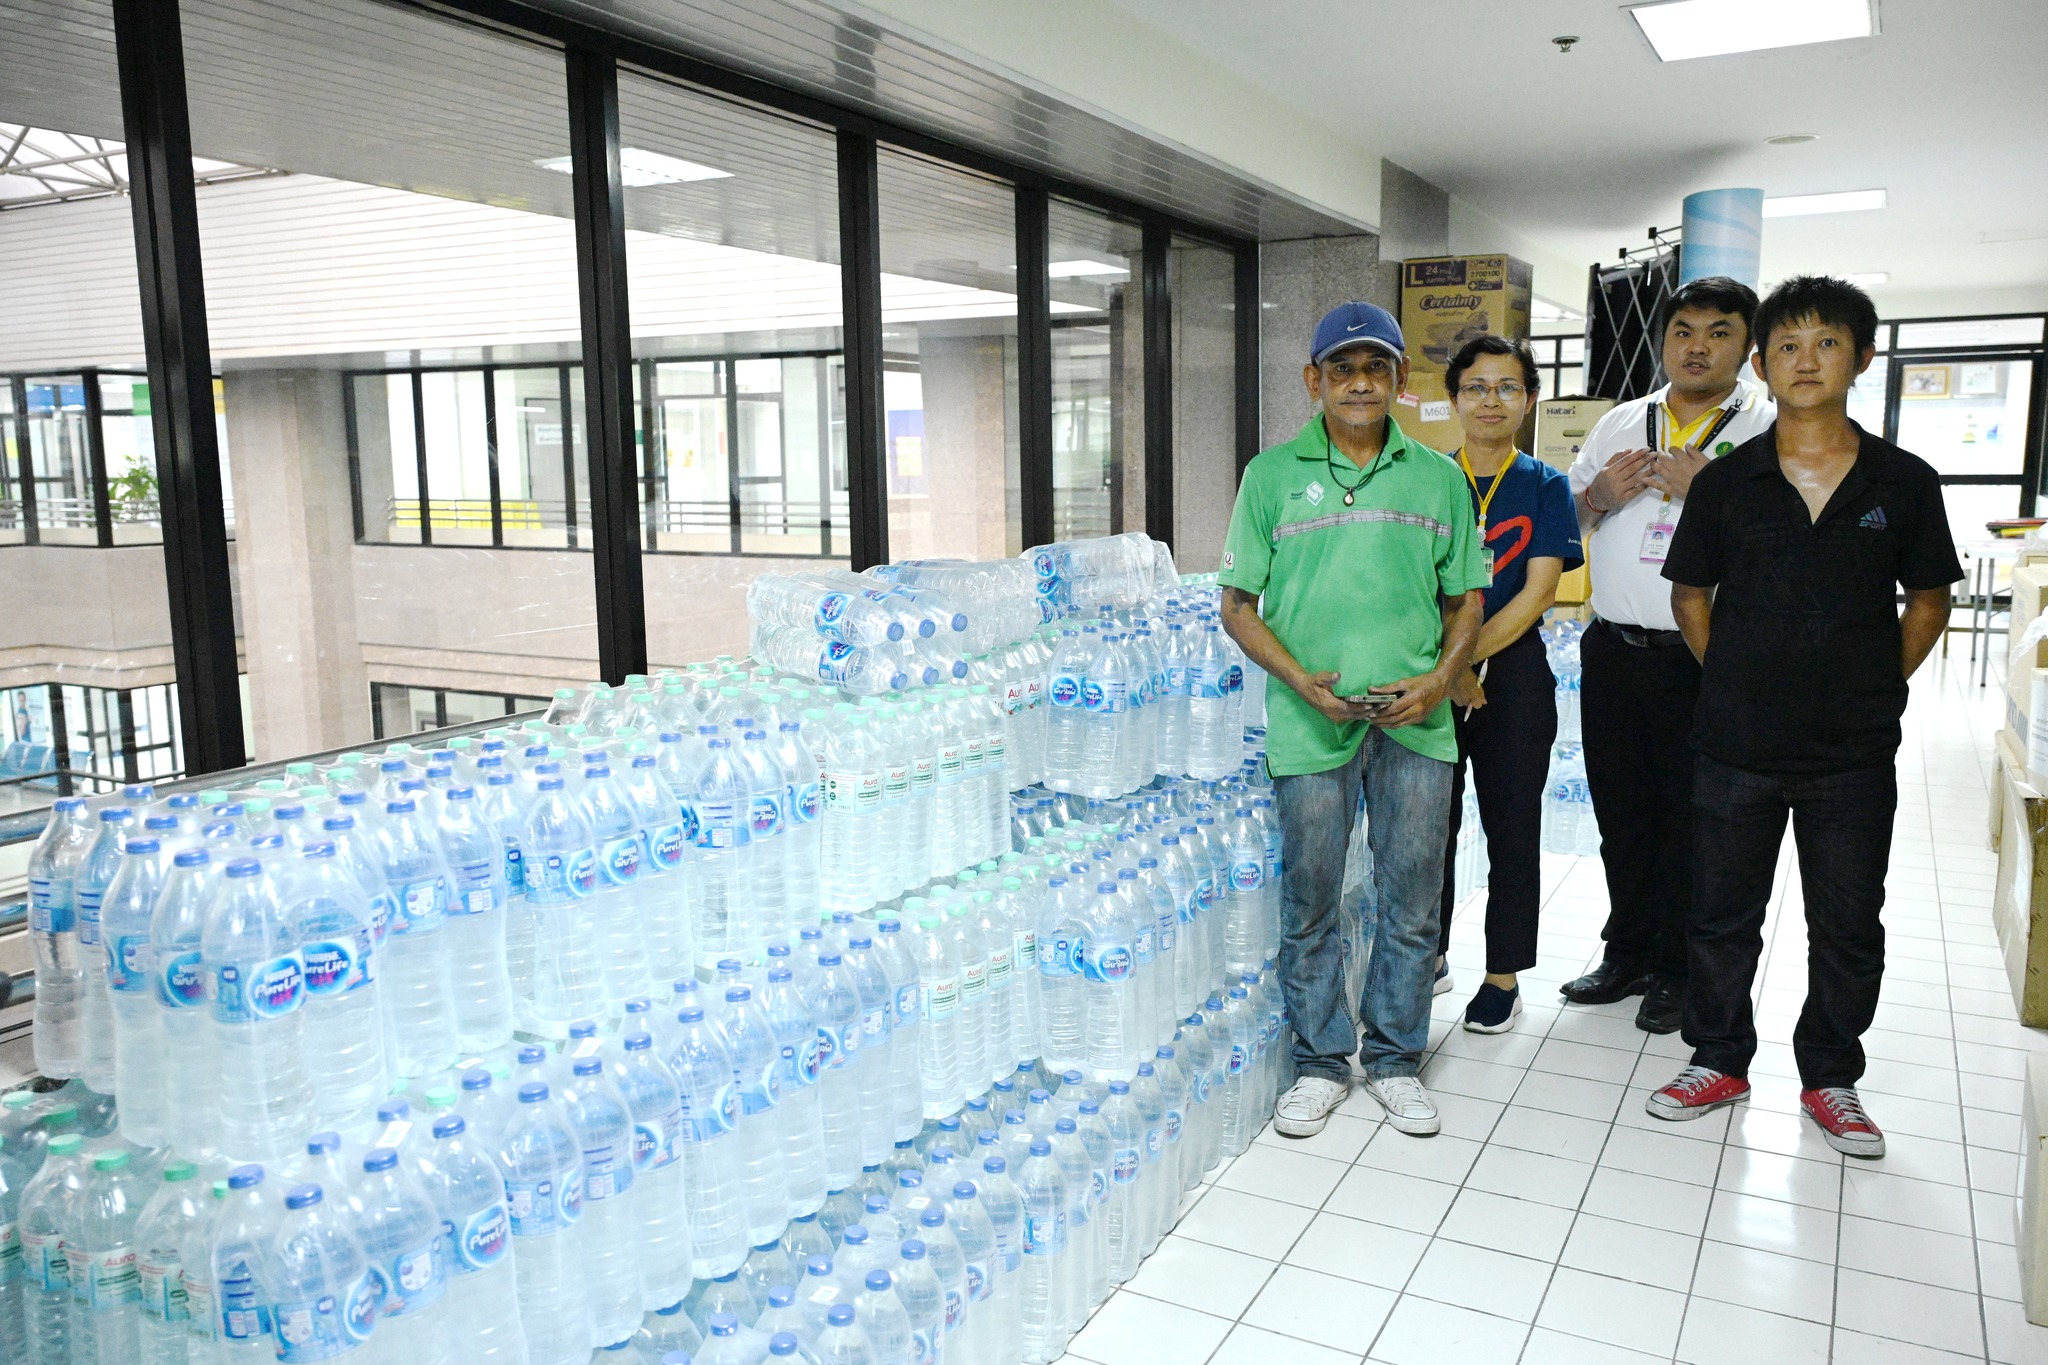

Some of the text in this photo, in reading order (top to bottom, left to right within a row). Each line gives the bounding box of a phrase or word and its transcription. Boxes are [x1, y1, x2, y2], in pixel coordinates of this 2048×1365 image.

[1411, 266, 1423, 285] L
[1425, 265, 1439, 275] 24
[1420, 294, 1482, 310] Certainty
[1546, 405, 1576, 415] Hatari
